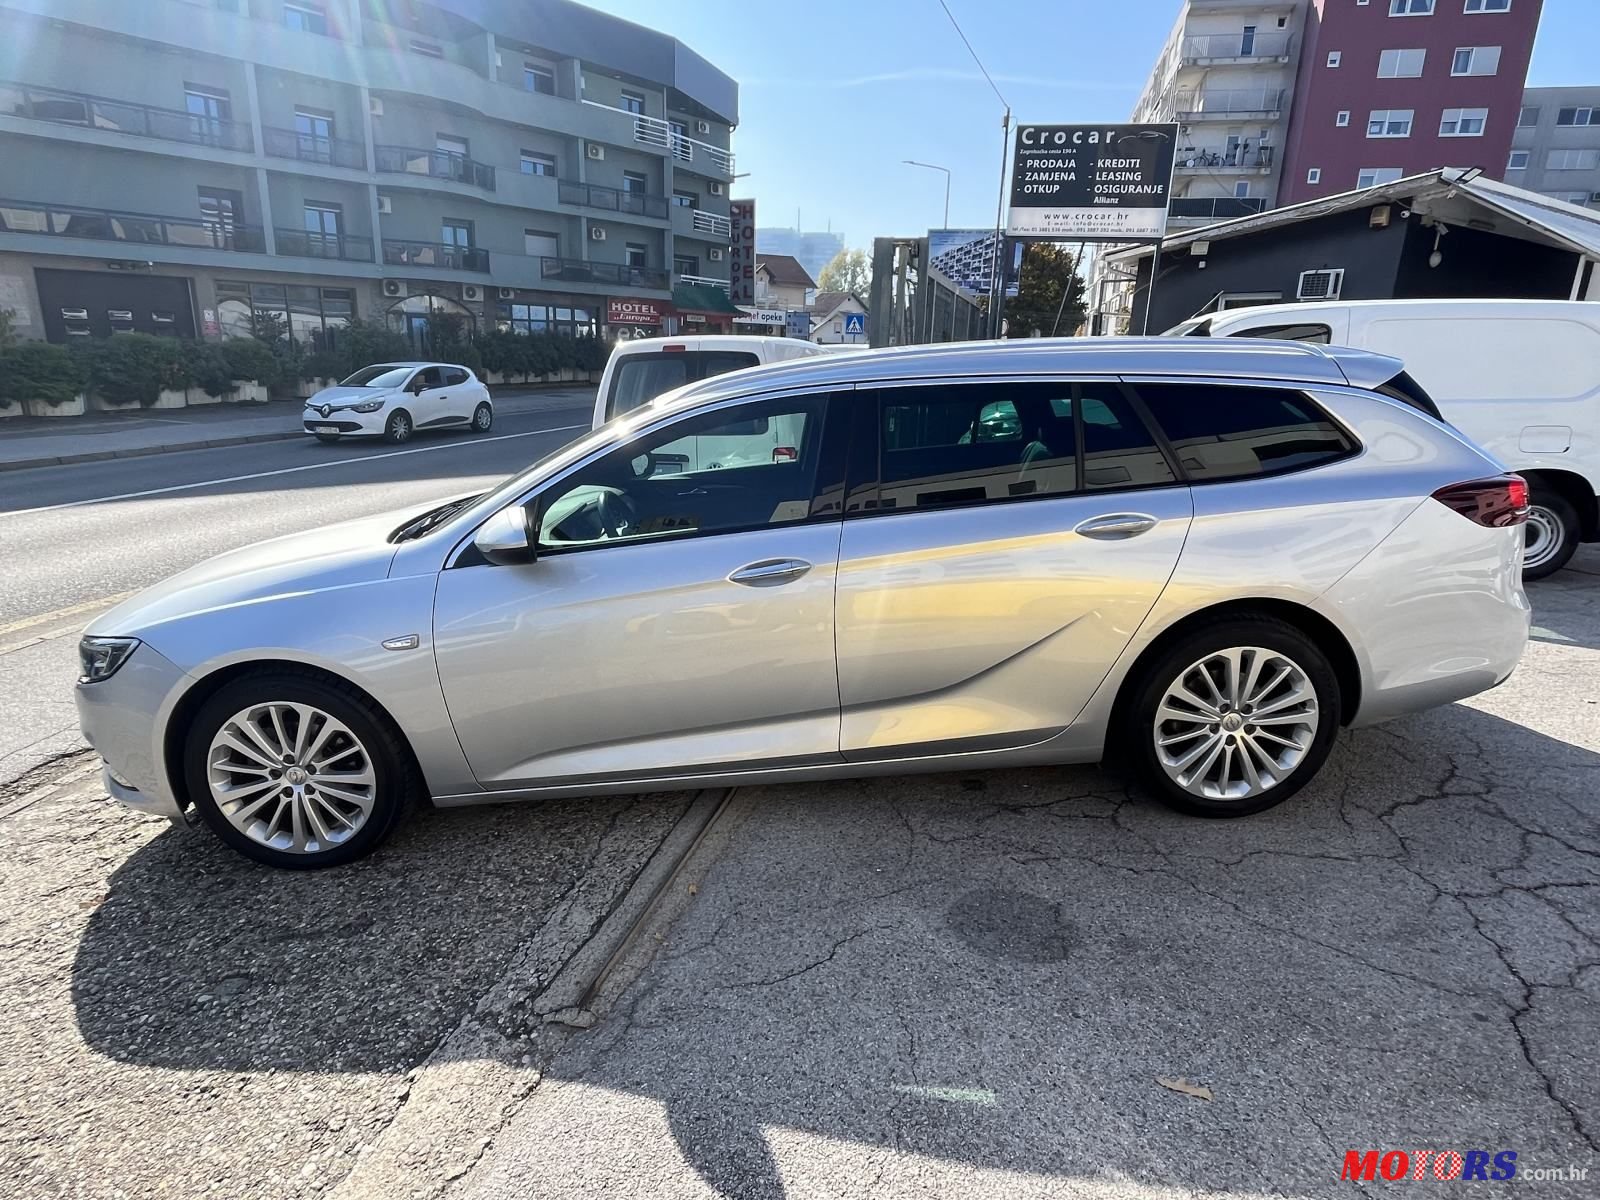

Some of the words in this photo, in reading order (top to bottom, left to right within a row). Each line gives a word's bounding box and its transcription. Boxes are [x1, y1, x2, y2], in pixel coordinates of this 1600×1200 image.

[1021, 127, 1116, 145] Crocar
[1026, 159, 1076, 168] PRODAJA
[1097, 158, 1141, 168] KREDITI
[1025, 171, 1076, 181] ZAMJENA
[1095, 171, 1142, 181] LEASING
[1024, 184, 1060, 194] OTKUP
[1094, 184, 1164, 194] OSIGURANJE
[1093, 196, 1119, 204] Allianz
[1044, 211, 1129, 220] www.crocar.hr
[742, 205, 753, 299] HOTEL
[731, 220, 740, 300] EUROPA
[611, 302, 657, 314] HOTEL
